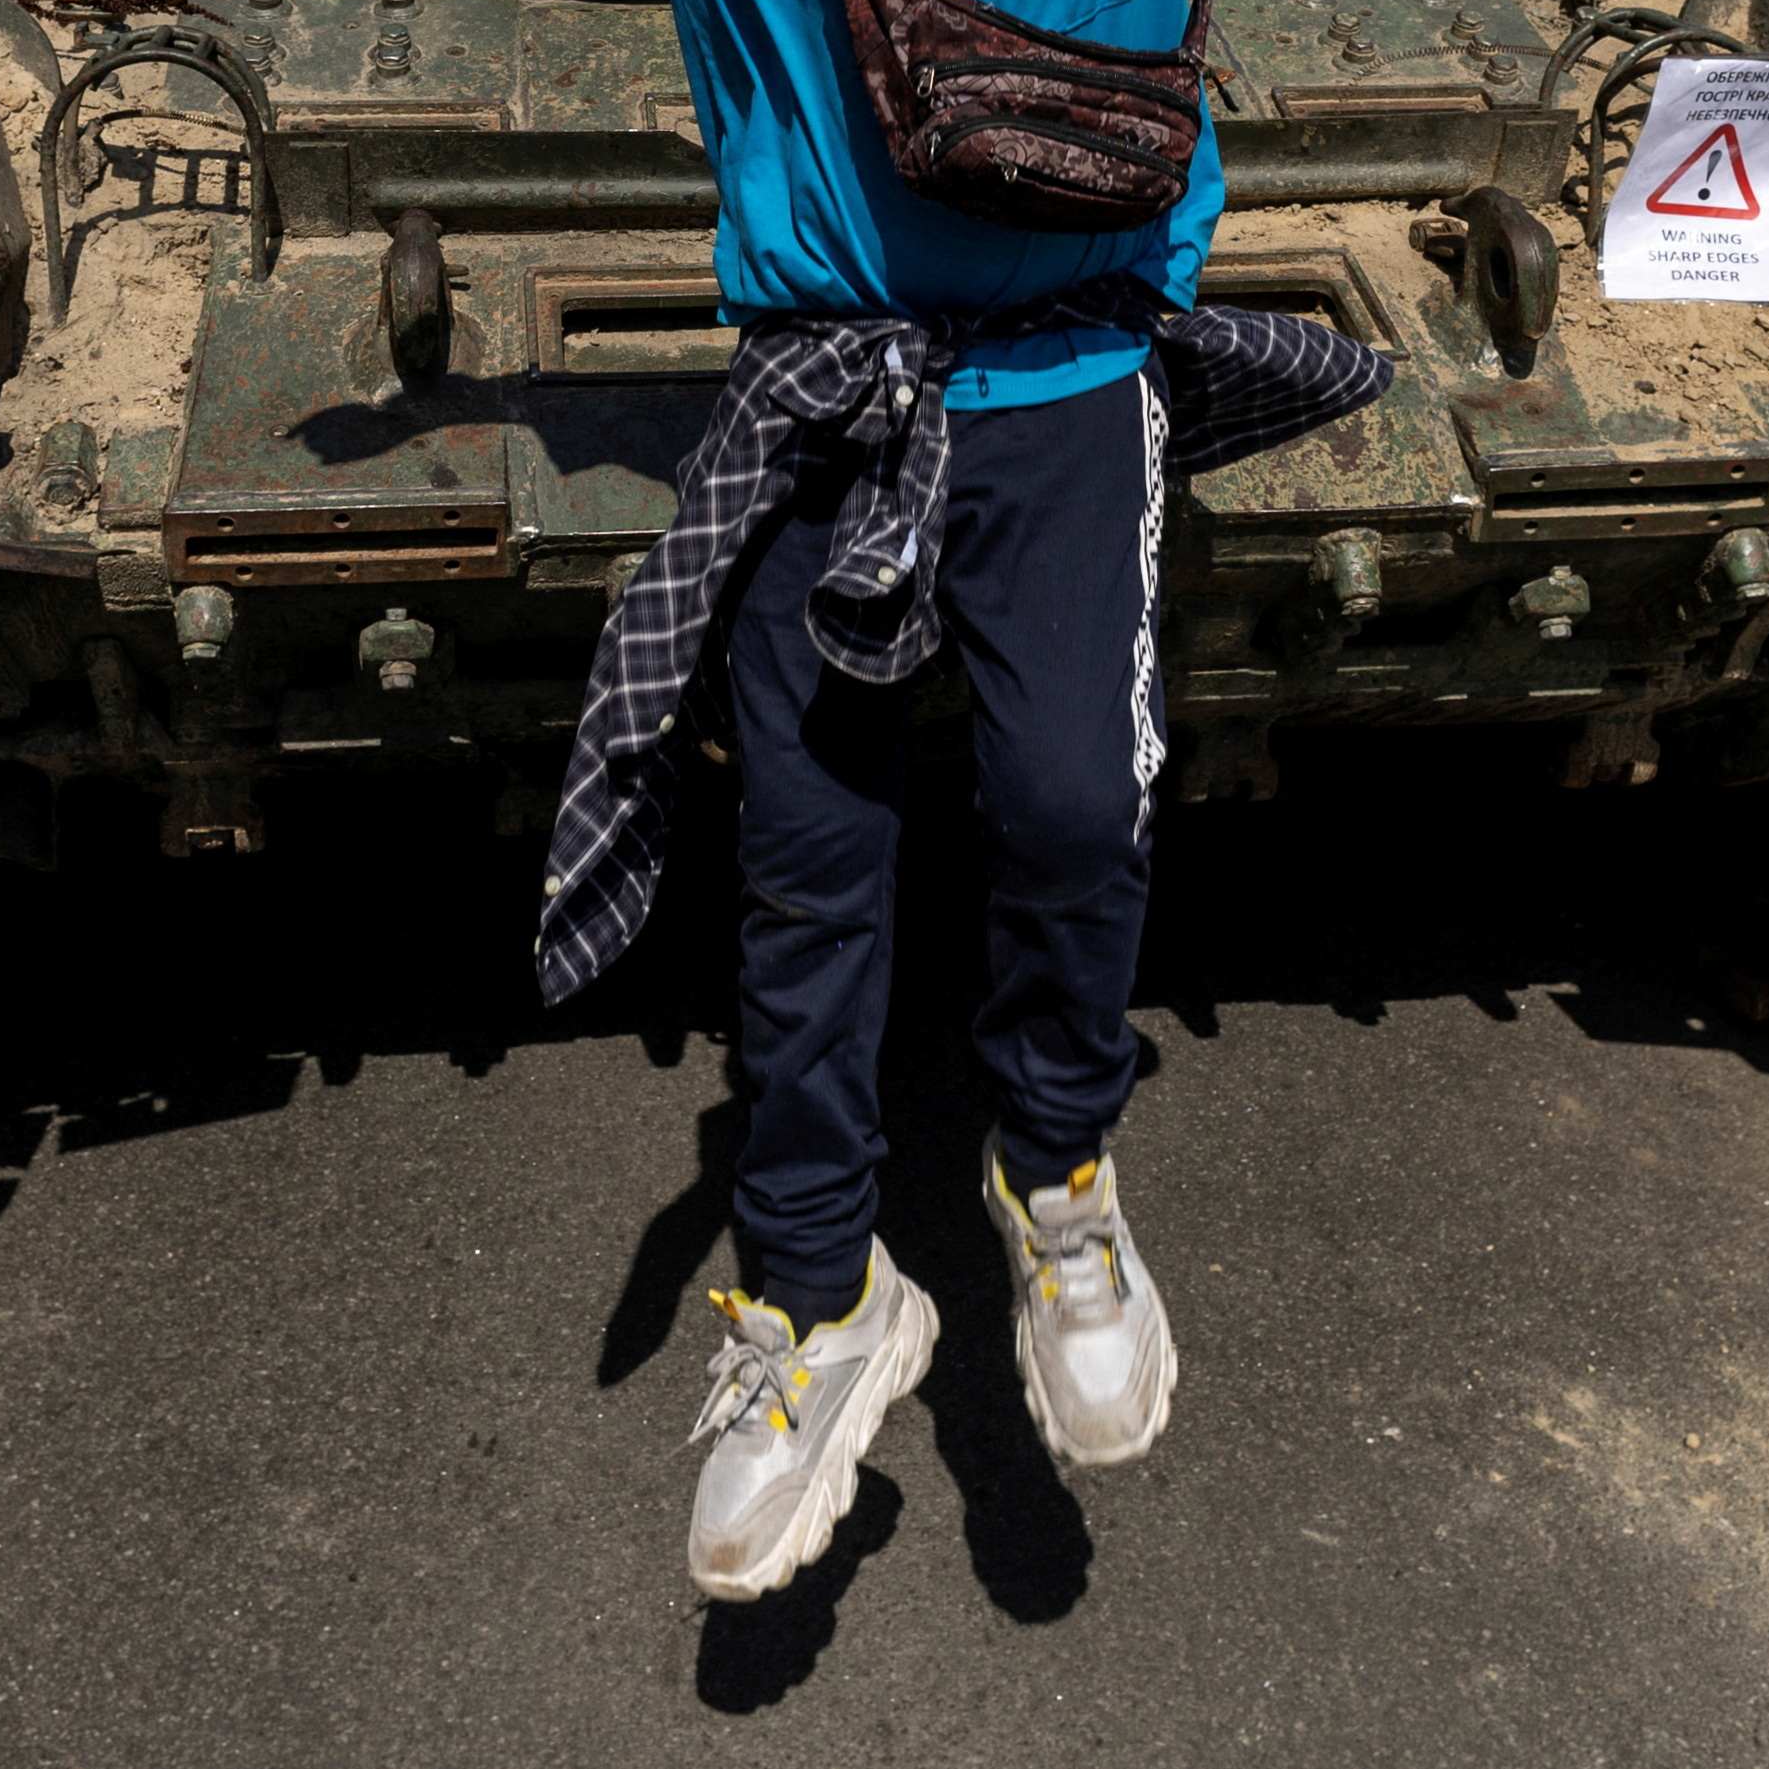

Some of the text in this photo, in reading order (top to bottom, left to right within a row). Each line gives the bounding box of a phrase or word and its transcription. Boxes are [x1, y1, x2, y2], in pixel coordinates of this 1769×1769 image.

[1695, 90, 1743, 103] ГОСТРІ
[1661, 229, 1742, 245] WANING
[1648, 250, 1759, 264] SHARP EDGES
[1671, 270, 1740, 282] DANGER
